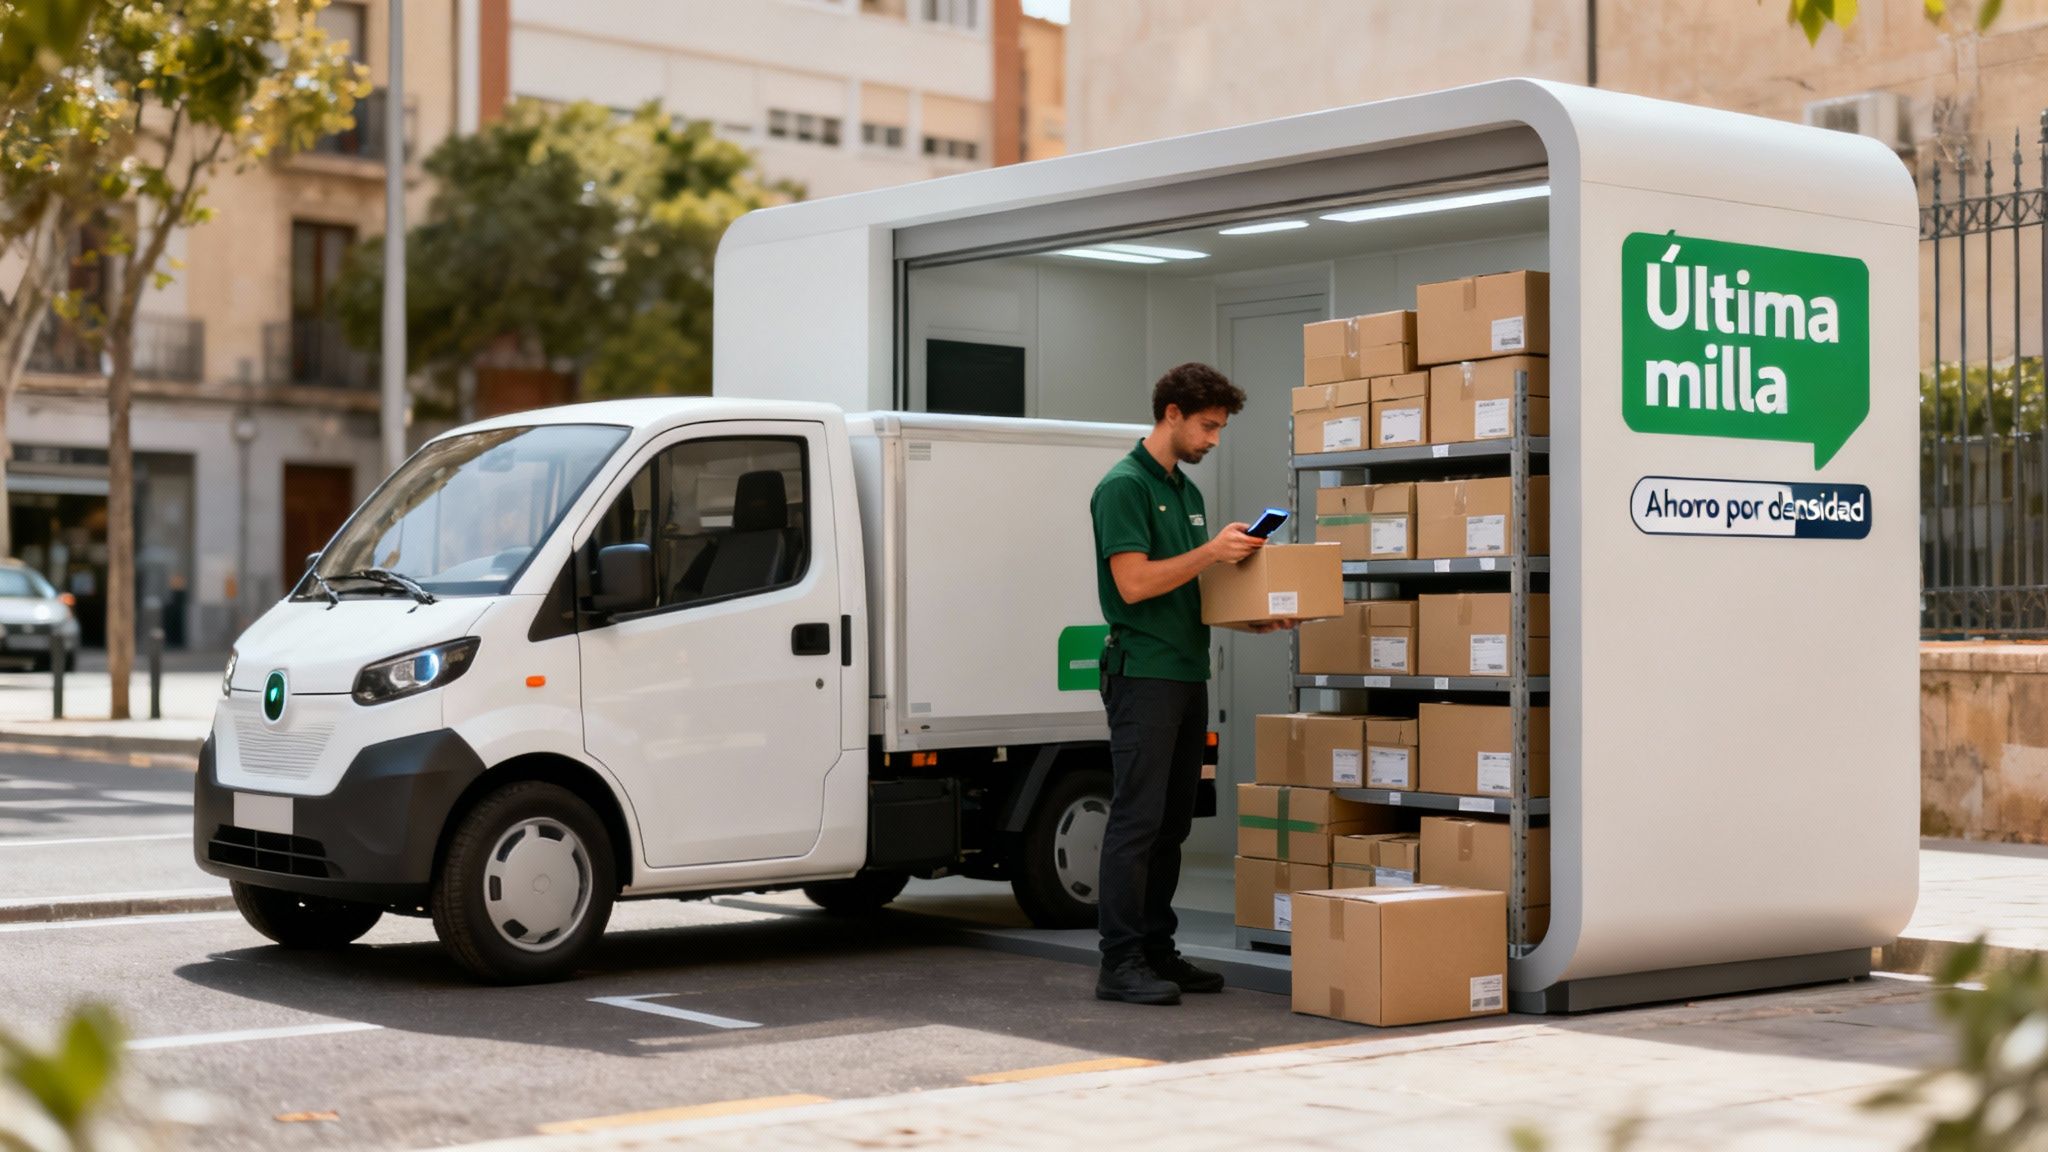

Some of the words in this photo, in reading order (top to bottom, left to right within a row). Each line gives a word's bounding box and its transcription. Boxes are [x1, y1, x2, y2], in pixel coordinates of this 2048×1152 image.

[1646, 243, 1839, 343] Última
[1646, 343, 1788, 414] milla
[1726, 499, 1763, 528] por
[1768, 491, 1864, 522] densidad
